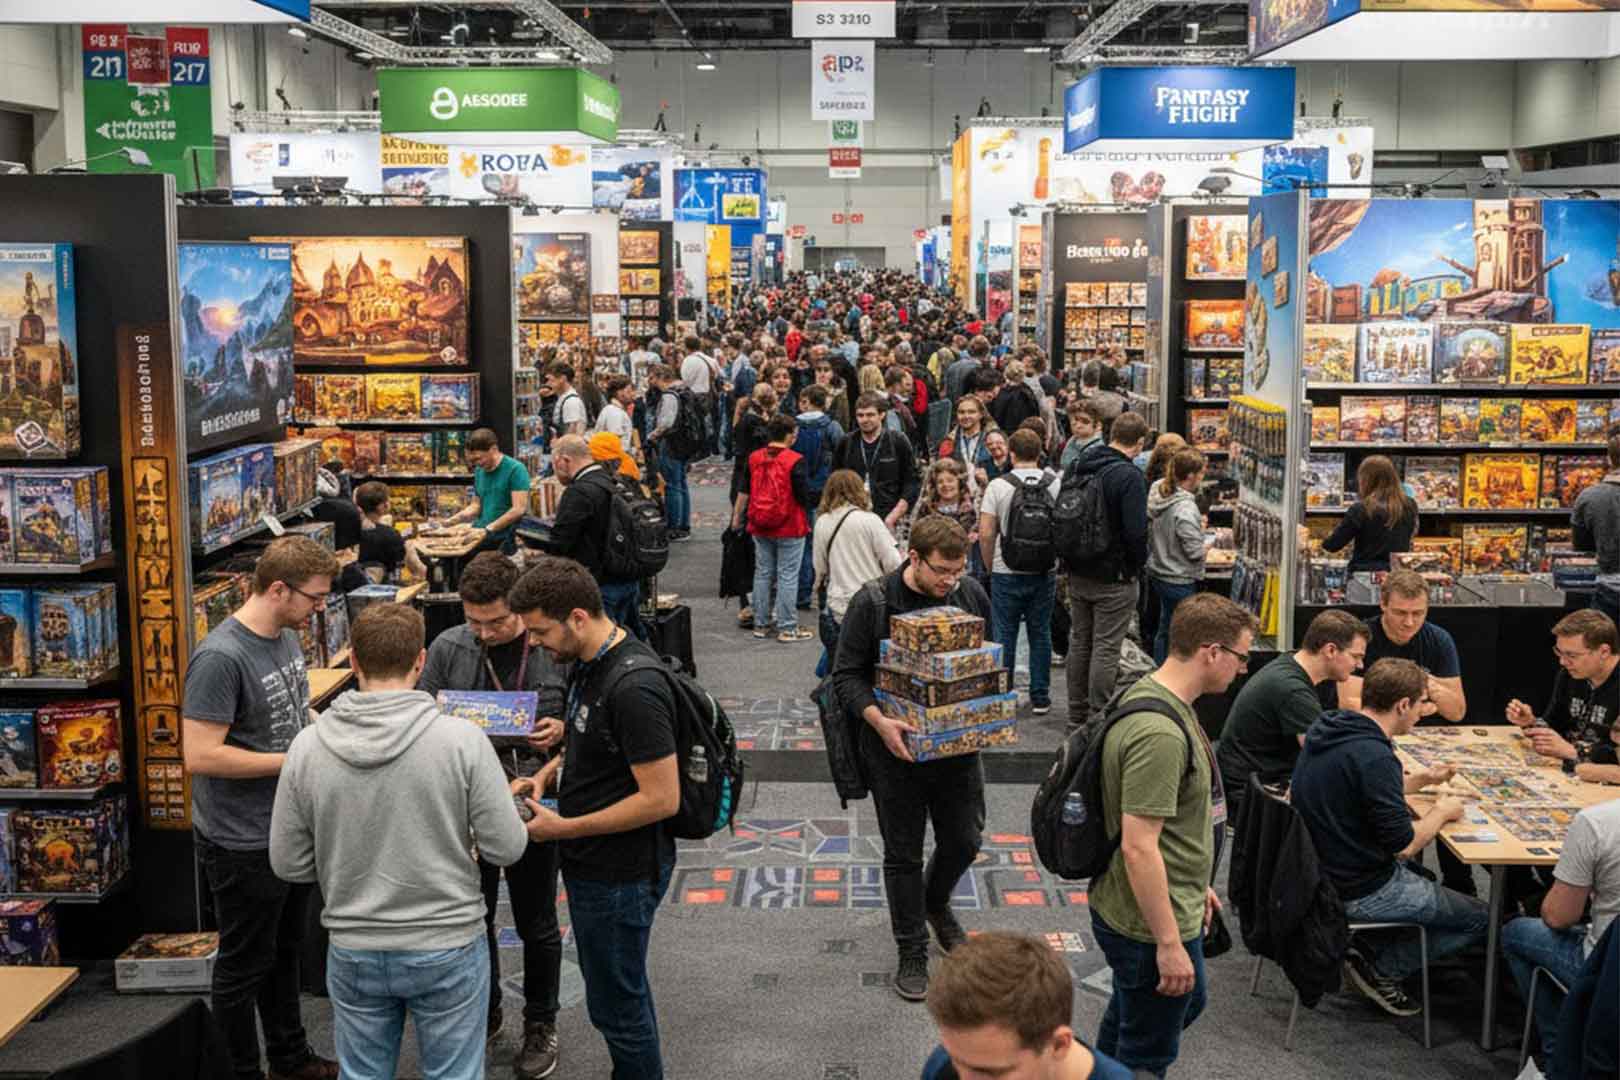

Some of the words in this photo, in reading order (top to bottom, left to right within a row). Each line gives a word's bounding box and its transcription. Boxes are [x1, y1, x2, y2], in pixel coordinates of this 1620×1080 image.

[815, 13, 835, 25] S3
[173, 62, 206, 83] 217
[1155, 87, 1250, 107] FANTASY
